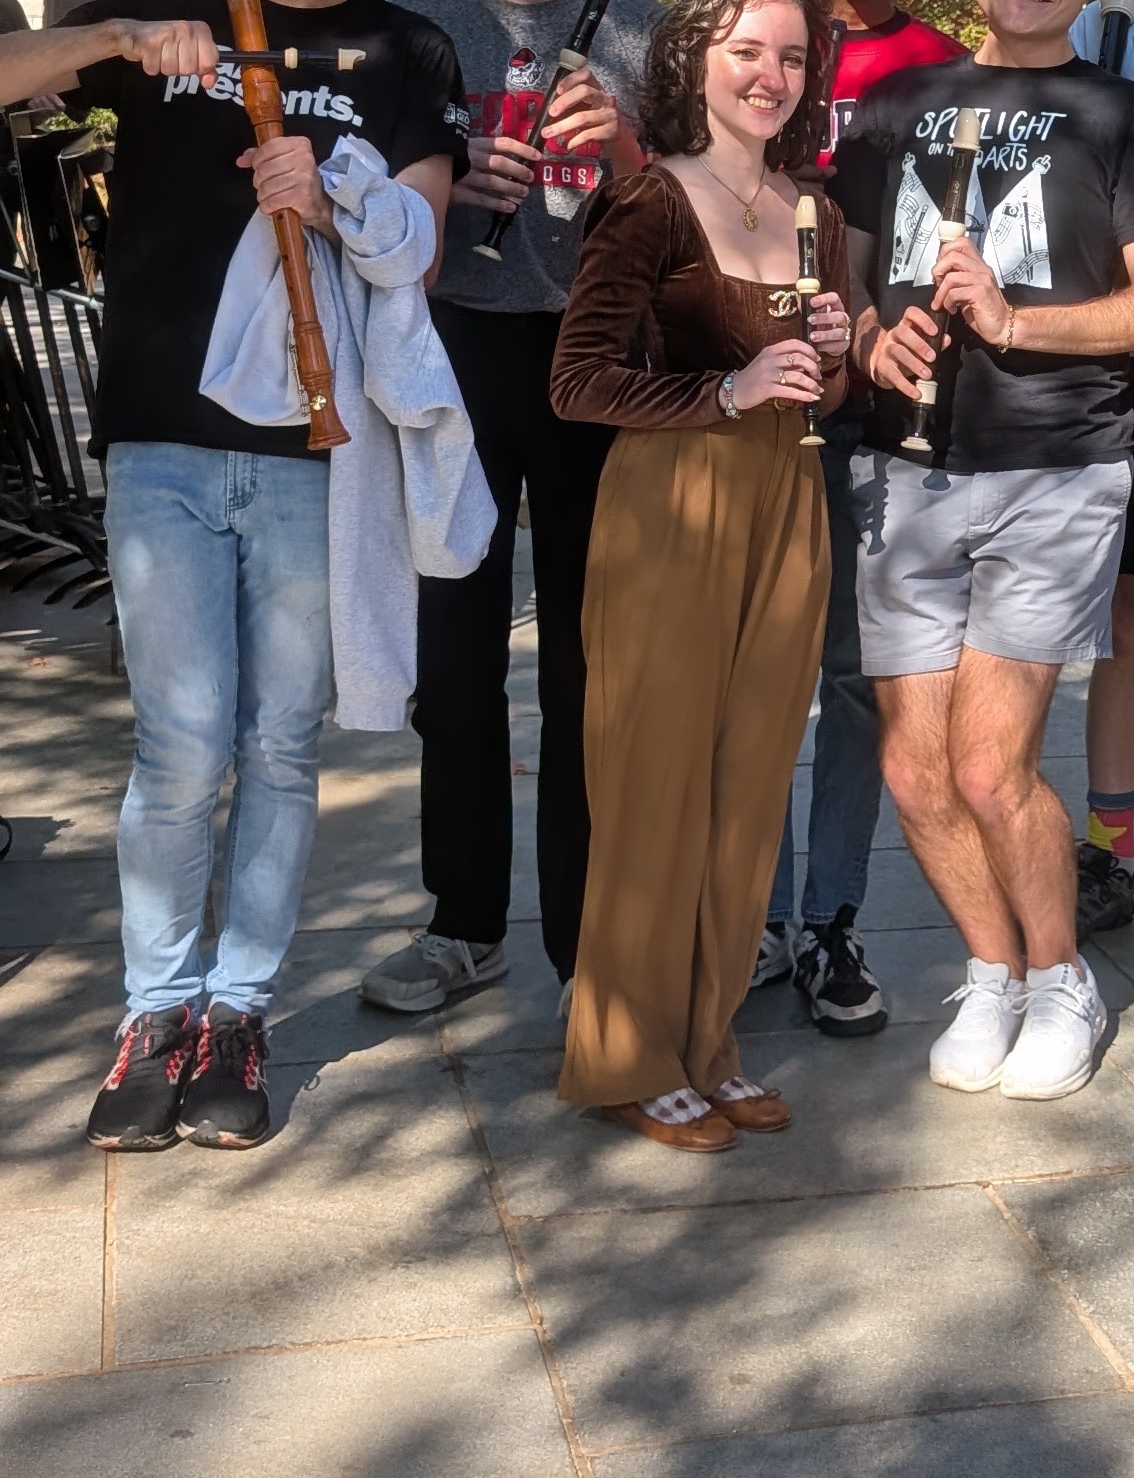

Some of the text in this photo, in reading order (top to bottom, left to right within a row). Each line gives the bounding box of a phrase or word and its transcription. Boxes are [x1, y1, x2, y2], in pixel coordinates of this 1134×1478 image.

[163, 73, 364, 128] presnts.
[915, 107, 1068, 142] SPLIGHT
[928, 142, 944, 155] ON
[982, 142, 1028, 172] ARTS
[543, 165, 588, 185] OGS
